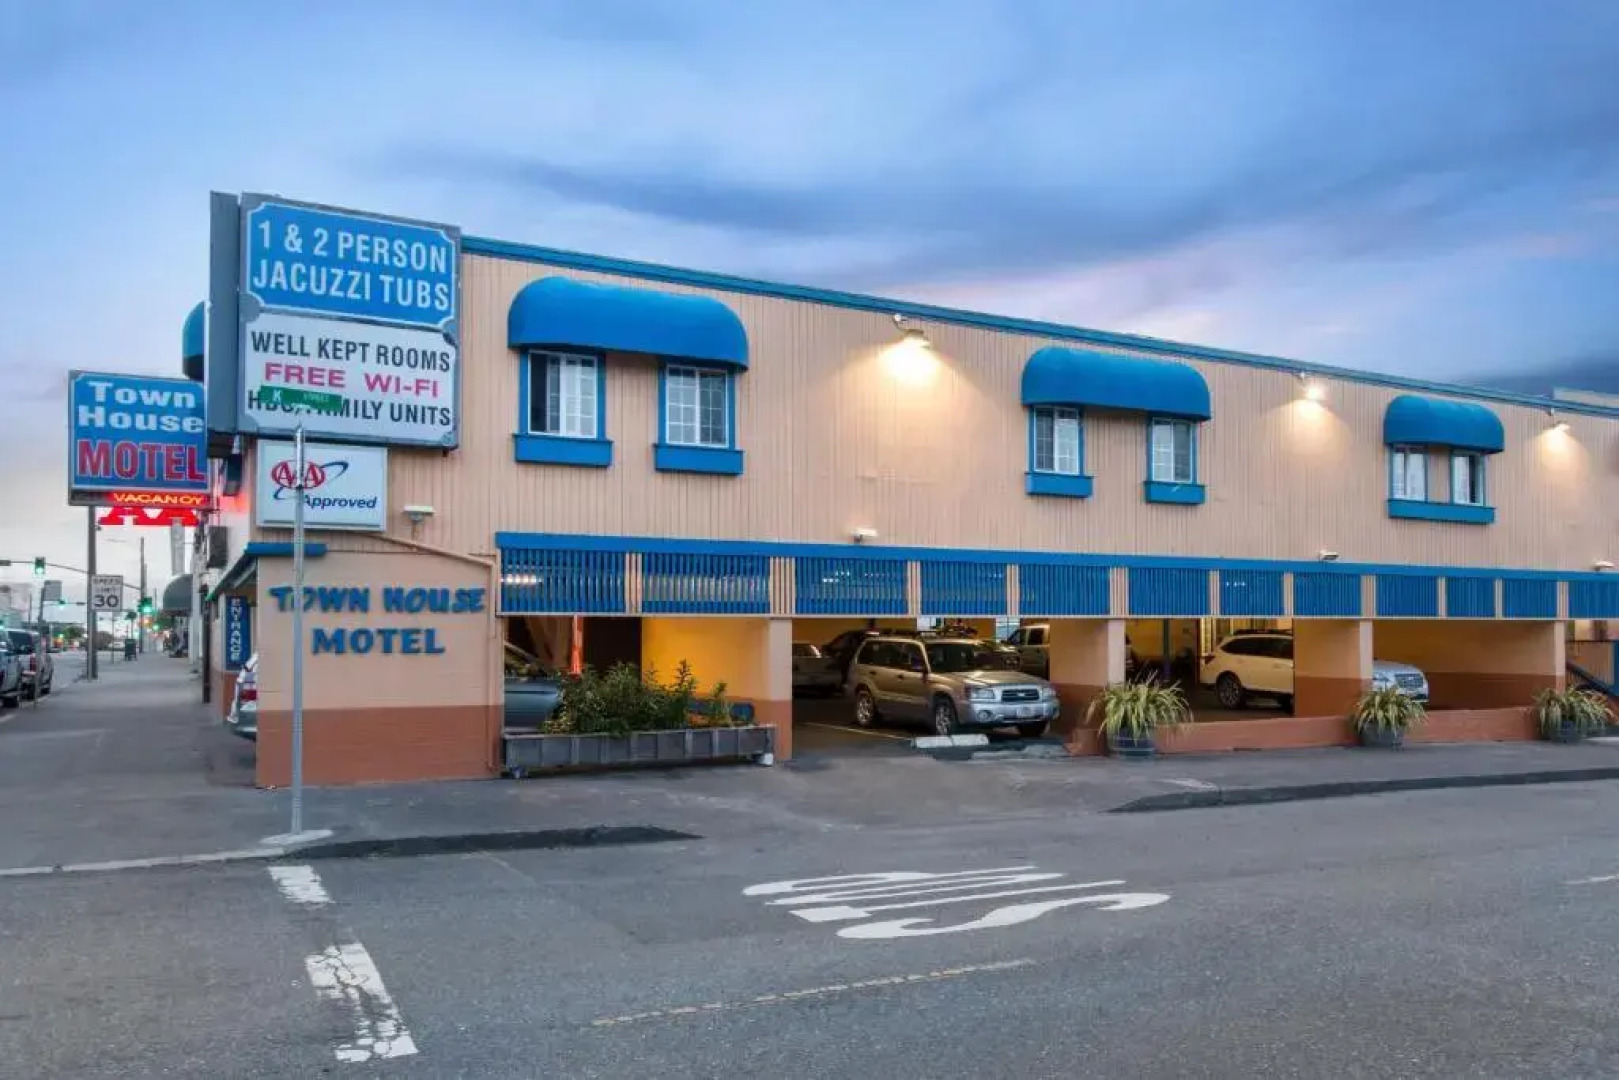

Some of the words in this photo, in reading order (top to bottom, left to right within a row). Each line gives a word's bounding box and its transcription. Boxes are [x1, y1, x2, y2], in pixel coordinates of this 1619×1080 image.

[258, 220, 271, 248] 1
[284, 223, 303, 254] &
[313, 227, 328, 257] 2
[337, 231, 446, 273] PERSON
[253, 259, 370, 301] JACUZZI
[379, 274, 449, 311] TUBS
[251, 331, 310, 357] WELL
[318, 338, 370, 363] KEPT
[376, 343, 450, 372] ROOMS
[265, 361, 346, 388] FREE
[364, 373, 438, 398] WI-FI
[88, 381, 195, 408] Town
[78, 404, 205, 433] House
[390, 405, 450, 426] UNITS
[77, 439, 206, 481] MOTEL
[113, 493, 202, 504] VACANCY
[95, 594, 119, 608] 30
[269, 586, 369, 613] TOWN
[383, 586, 485, 613] HOUSE
[312, 627, 446, 655] MOTEL
